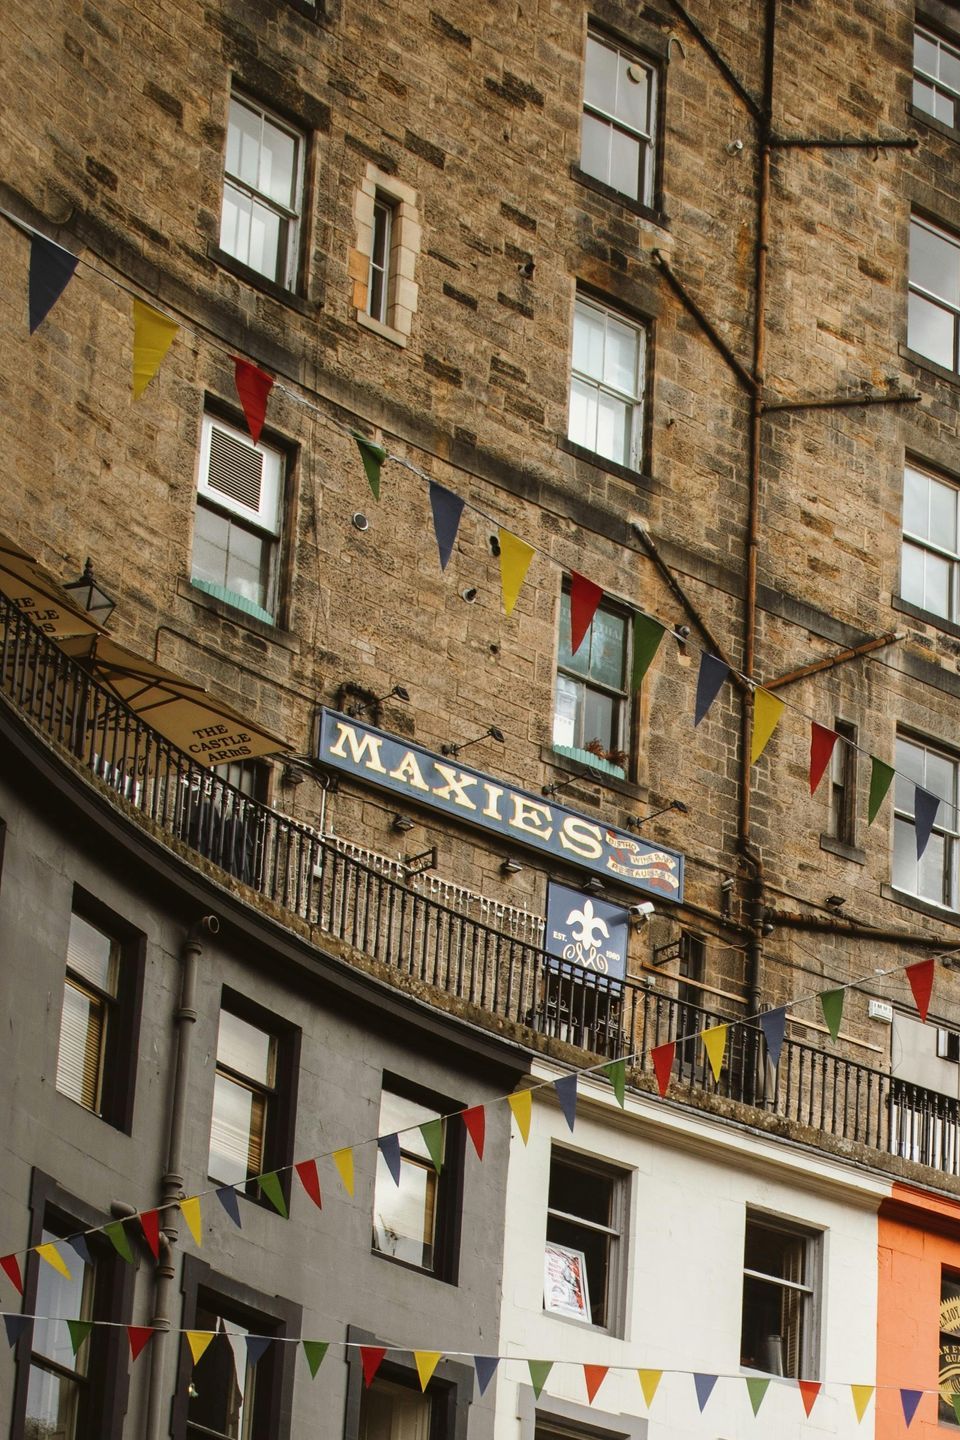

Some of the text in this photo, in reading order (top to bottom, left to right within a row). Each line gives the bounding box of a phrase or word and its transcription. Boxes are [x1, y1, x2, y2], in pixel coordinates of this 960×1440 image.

[12, 597, 35, 608] HE
[192, 724, 228, 739] THE
[188, 733, 251, 753] CASTLE
[330, 722, 603, 859] MAXIES
[553, 931, 567, 942] EST.
